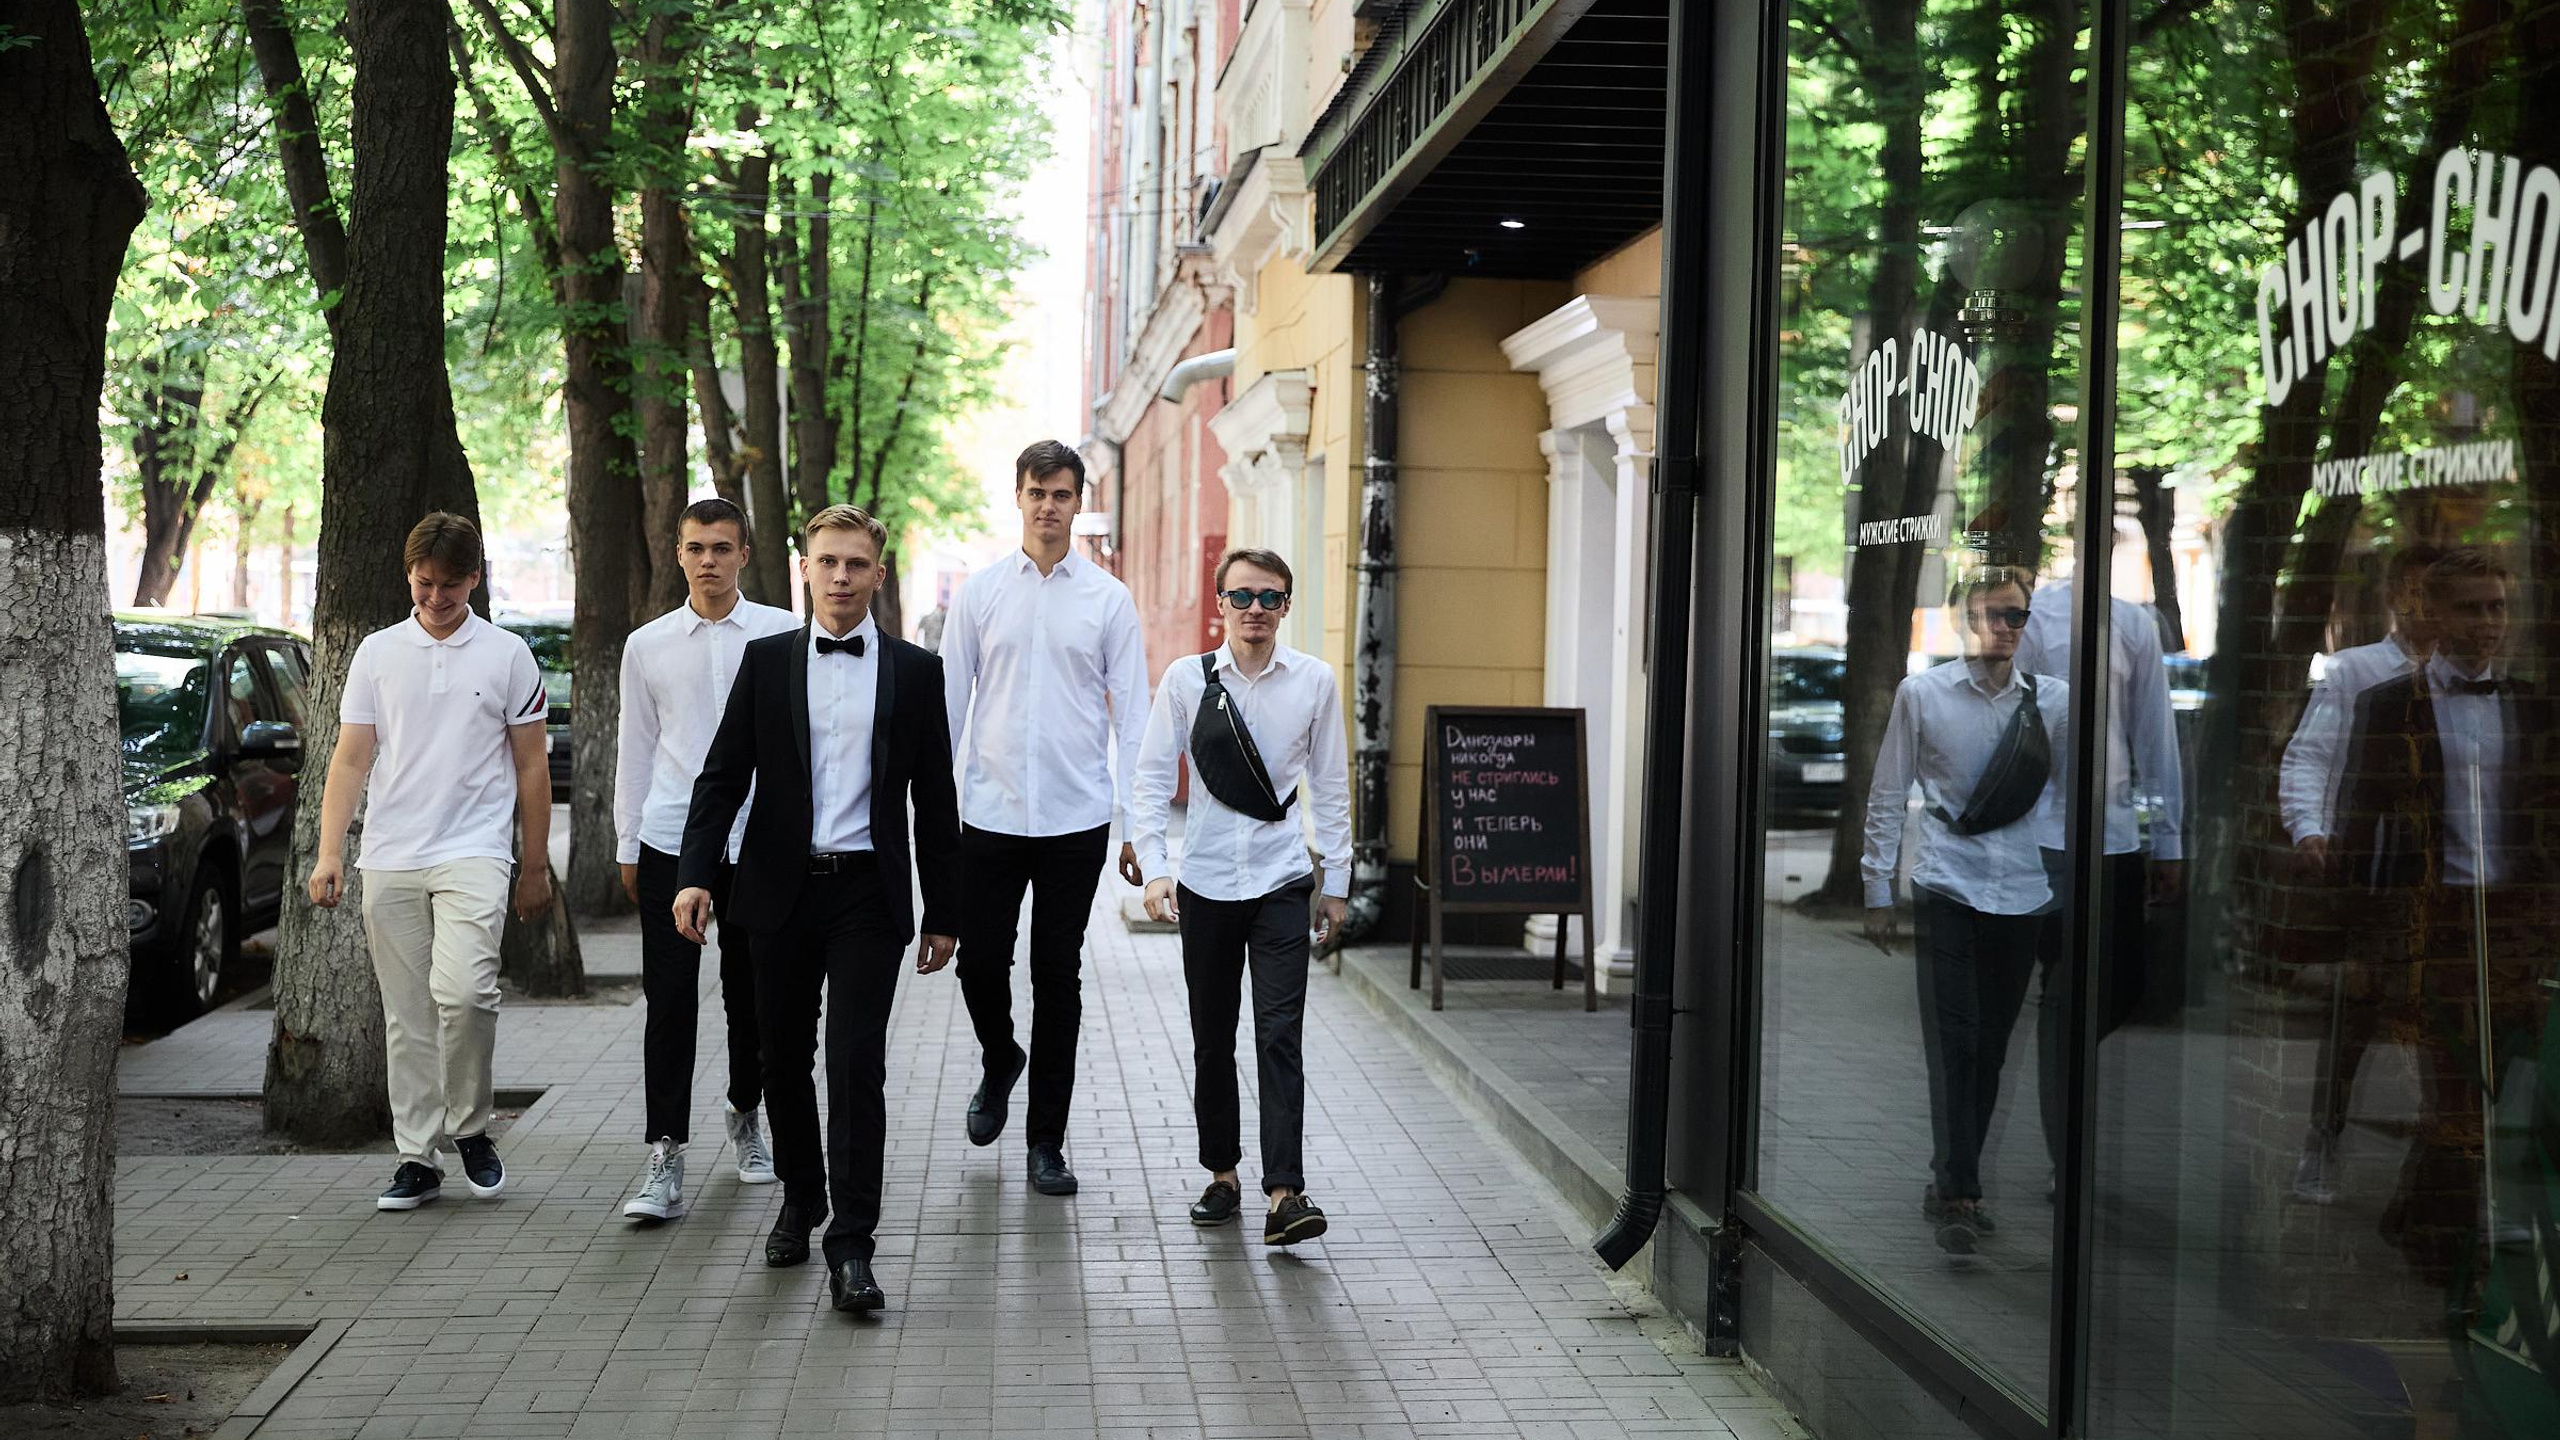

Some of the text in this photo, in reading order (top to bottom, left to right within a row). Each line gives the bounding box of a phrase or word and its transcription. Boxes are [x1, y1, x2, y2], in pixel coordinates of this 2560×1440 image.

[2256, 148, 2560, 408] CHOP-CHO
[1838, 327, 1980, 486] CHOP-CHOP
[2312, 439, 2514, 498] МУЖСКИЕ СТРИЖКИ
[1859, 513, 1942, 546] МУЖСКИЕ СТРИЖКИ
